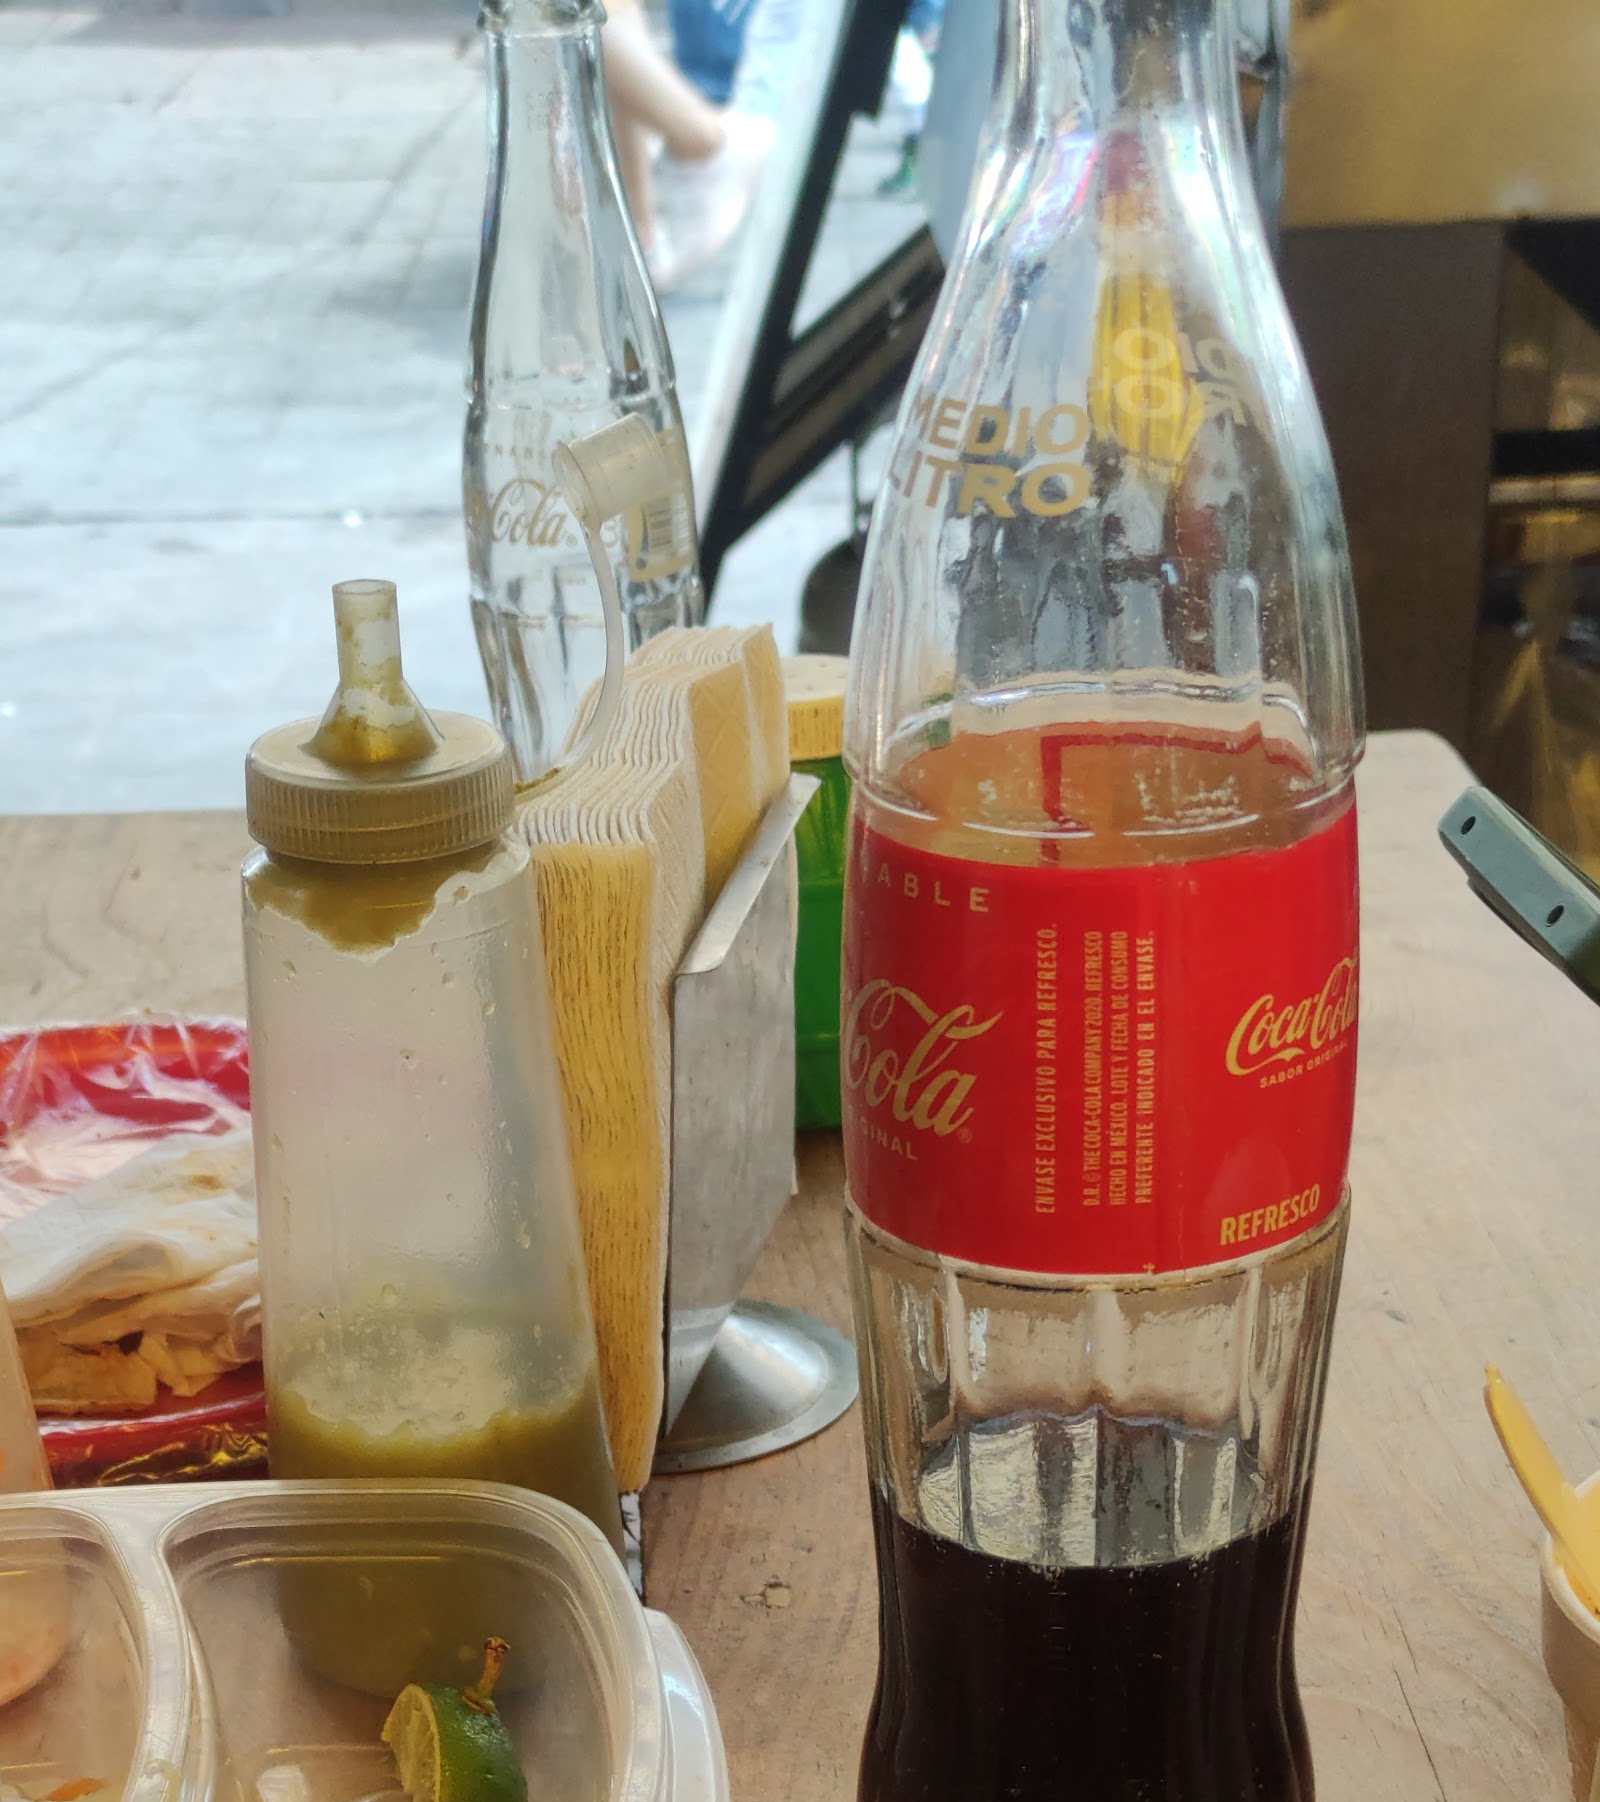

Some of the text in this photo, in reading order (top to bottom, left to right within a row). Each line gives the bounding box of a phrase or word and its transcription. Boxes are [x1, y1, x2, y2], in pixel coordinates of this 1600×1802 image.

[908, 394, 1090, 456] MEDIO
[888, 450, 1091, 518] LITRO
[1084, 930, 1103, 992] REFRESCO
[1110, 931, 1129, 990] CONSUMO
[1110, 994, 1129, 1010] DE
[1136, 998, 1155, 1015] EL
[1036, 1017, 1056, 1059] PARA
[1110, 1012, 1129, 1051] FECHA
[1137, 1023, 1155, 1041] EN
[1084, 1027, 1102, 1084] COMPANY
[1110, 1054, 1128, 1063] Y
[1259, 1064, 1303, 1089] SABOR
[1109, 1065, 1128, 1095] LOTE
[1136, 1048, 1155, 1115] INDICADO
[1035, 1065, 1056, 1152] EXCLUSIVO
[1083, 1150, 1101, 1171] THE
[1108, 1150, 1127, 1166] EN
[1135, 1122, 1154, 1204] PREFERENTE
[1035, 1157, 1056, 1214] ENVASE
[1108, 1168, 1127, 1206] HECHO
[1219, 1183, 1321, 1246] REFRESCO
